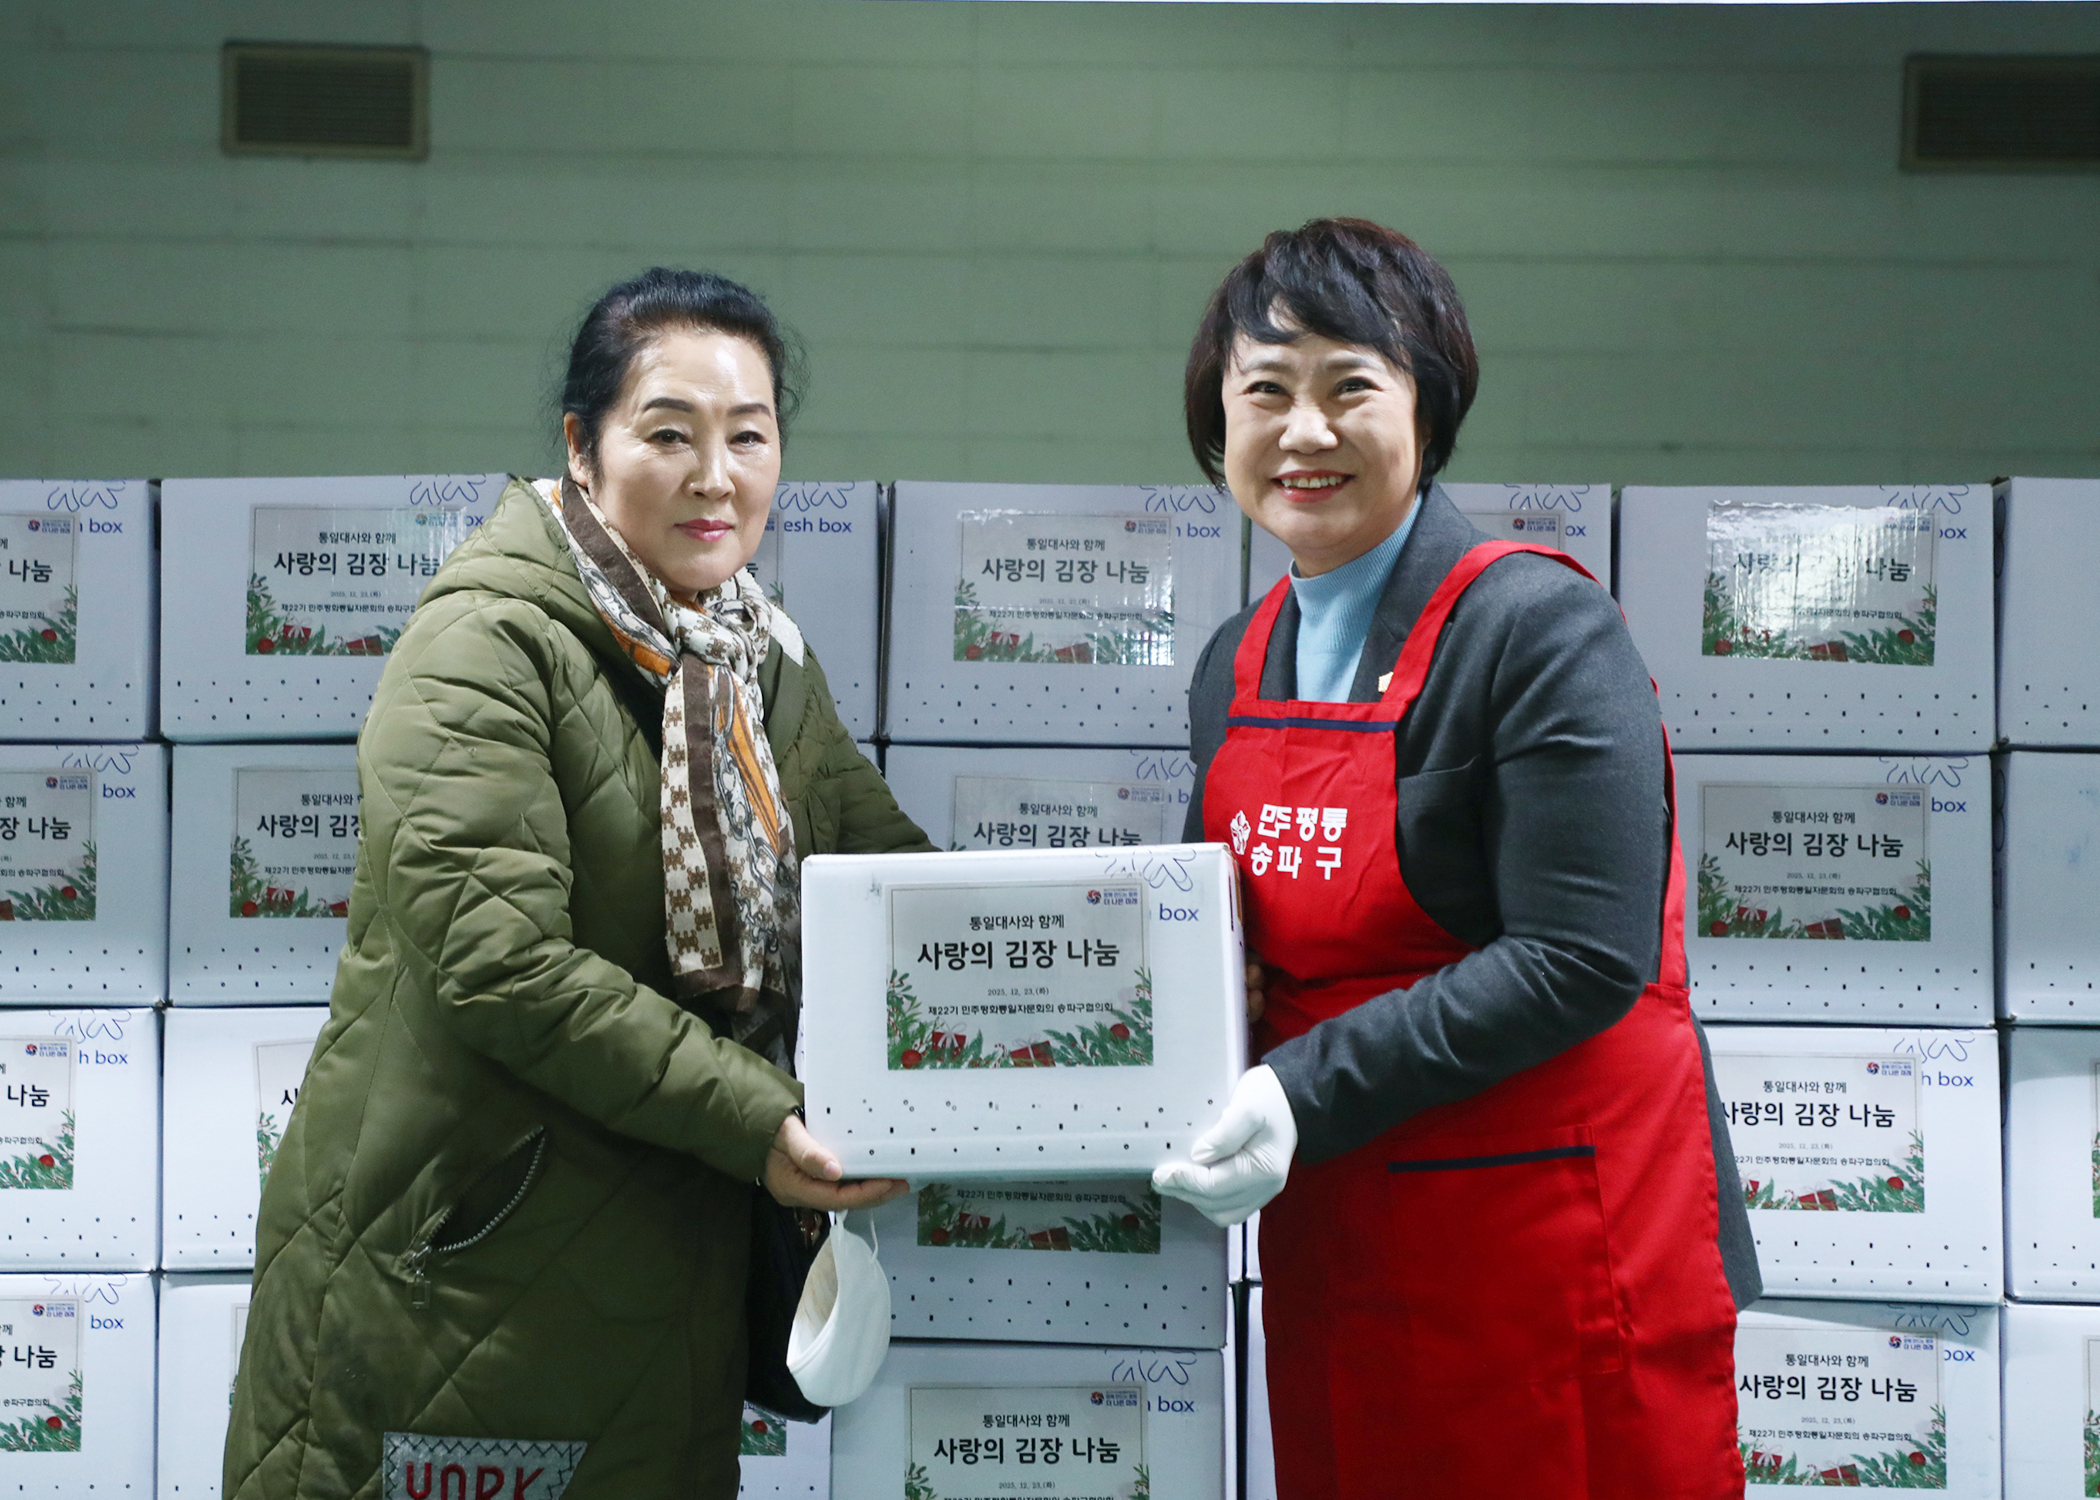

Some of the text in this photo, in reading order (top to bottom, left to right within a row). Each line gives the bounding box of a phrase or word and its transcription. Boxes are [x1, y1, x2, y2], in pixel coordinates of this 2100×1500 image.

[89, 519, 123, 533] box
[819, 518, 852, 532] box
[1188, 523, 1220, 538] box
[318, 532, 396, 544] 통일대사와 함께
[1027, 538, 1105, 550] 통일대사와 함께
[9, 560, 52, 583] 나눔
[274, 552, 336, 576] 사랑의
[347, 553, 388, 576] 김장
[982, 558, 1149, 583] 사랑의 김장 나눔
[1866, 557, 1910, 582] 나눔
[103, 784, 136, 798] box
[5, 797, 27, 808] 함께
[301, 794, 353, 806] 통일대사와
[1932, 798, 1966, 812] box
[1018, 802, 1098, 818] 통일대사와 함께
[1257, 804, 1347, 842] 민주평통
[1772, 812, 1855, 824] 통일대사와 함께
[28, 817, 71, 840] 나눔
[257, 815, 319, 838] 사랑의
[974, 823, 1037, 847] 사랑의
[1048, 826, 1090, 848] 김장
[1725, 833, 1903, 858] 사랑의 김장 나눔
[1159, 904, 1199, 922] box
[969, 914, 1065, 930] 통일대사와 함께
[918, 939, 1119, 970] 사랑의 김장 나눔
[929, 1006, 958, 1015] 제22기
[1057, 1003, 1113, 1014] 송파구협의회
[95, 1050, 128, 1064] box
[1938, 1072, 1974, 1087] box
[1763, 1081, 1847, 1094] 통일대사와 함께
[8, 1084, 50, 1107] 나눔
[1723, 1102, 1895, 1127] 사랑의 김장 나눔
[91, 1315, 124, 1329] box
[14, 1346, 57, 1368] 나눔
[1785, 1354, 1869, 1368] 통일대사와 함께
[1740, 1375, 1917, 1402] 사랑의 김장 나눔
[4, 1399, 50, 1407] 송파구협의회
[1158, 1396, 1195, 1413] box
[983, 1414, 1070, 1428] 통일대사와 함께
[1749, 1429, 1775, 1438] 제22기
[934, 1437, 1120, 1465] 사랑의 김장 나눔
